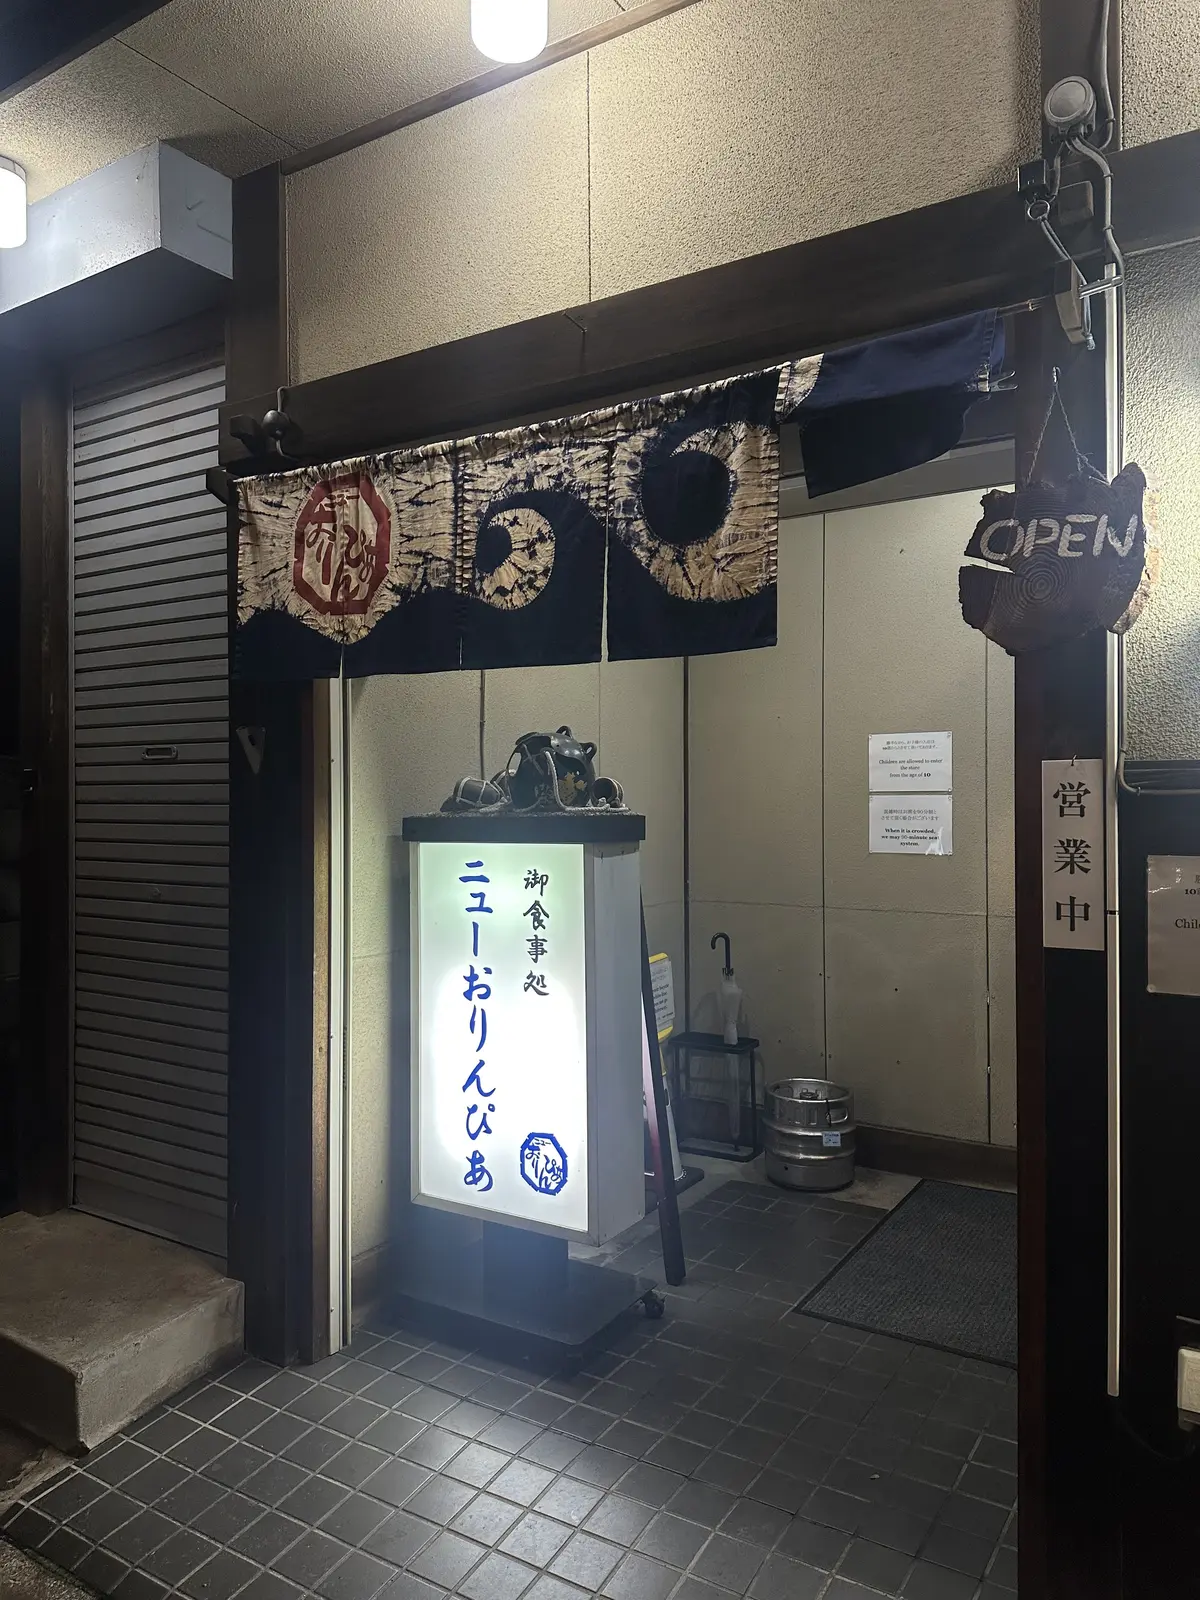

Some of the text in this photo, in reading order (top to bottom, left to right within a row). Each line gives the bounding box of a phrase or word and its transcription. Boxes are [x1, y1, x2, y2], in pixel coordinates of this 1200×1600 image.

[980, 514, 1138, 562] OPEN
[1053, 781, 1092, 931] 営業中
[523, 868, 550, 997] 御食事処
[459, 859, 496, 1193] ニューおりんぴあ
[525, 1145, 562, 1189] おりんぴあ
[534, 1138, 551, 1146] ニュー
